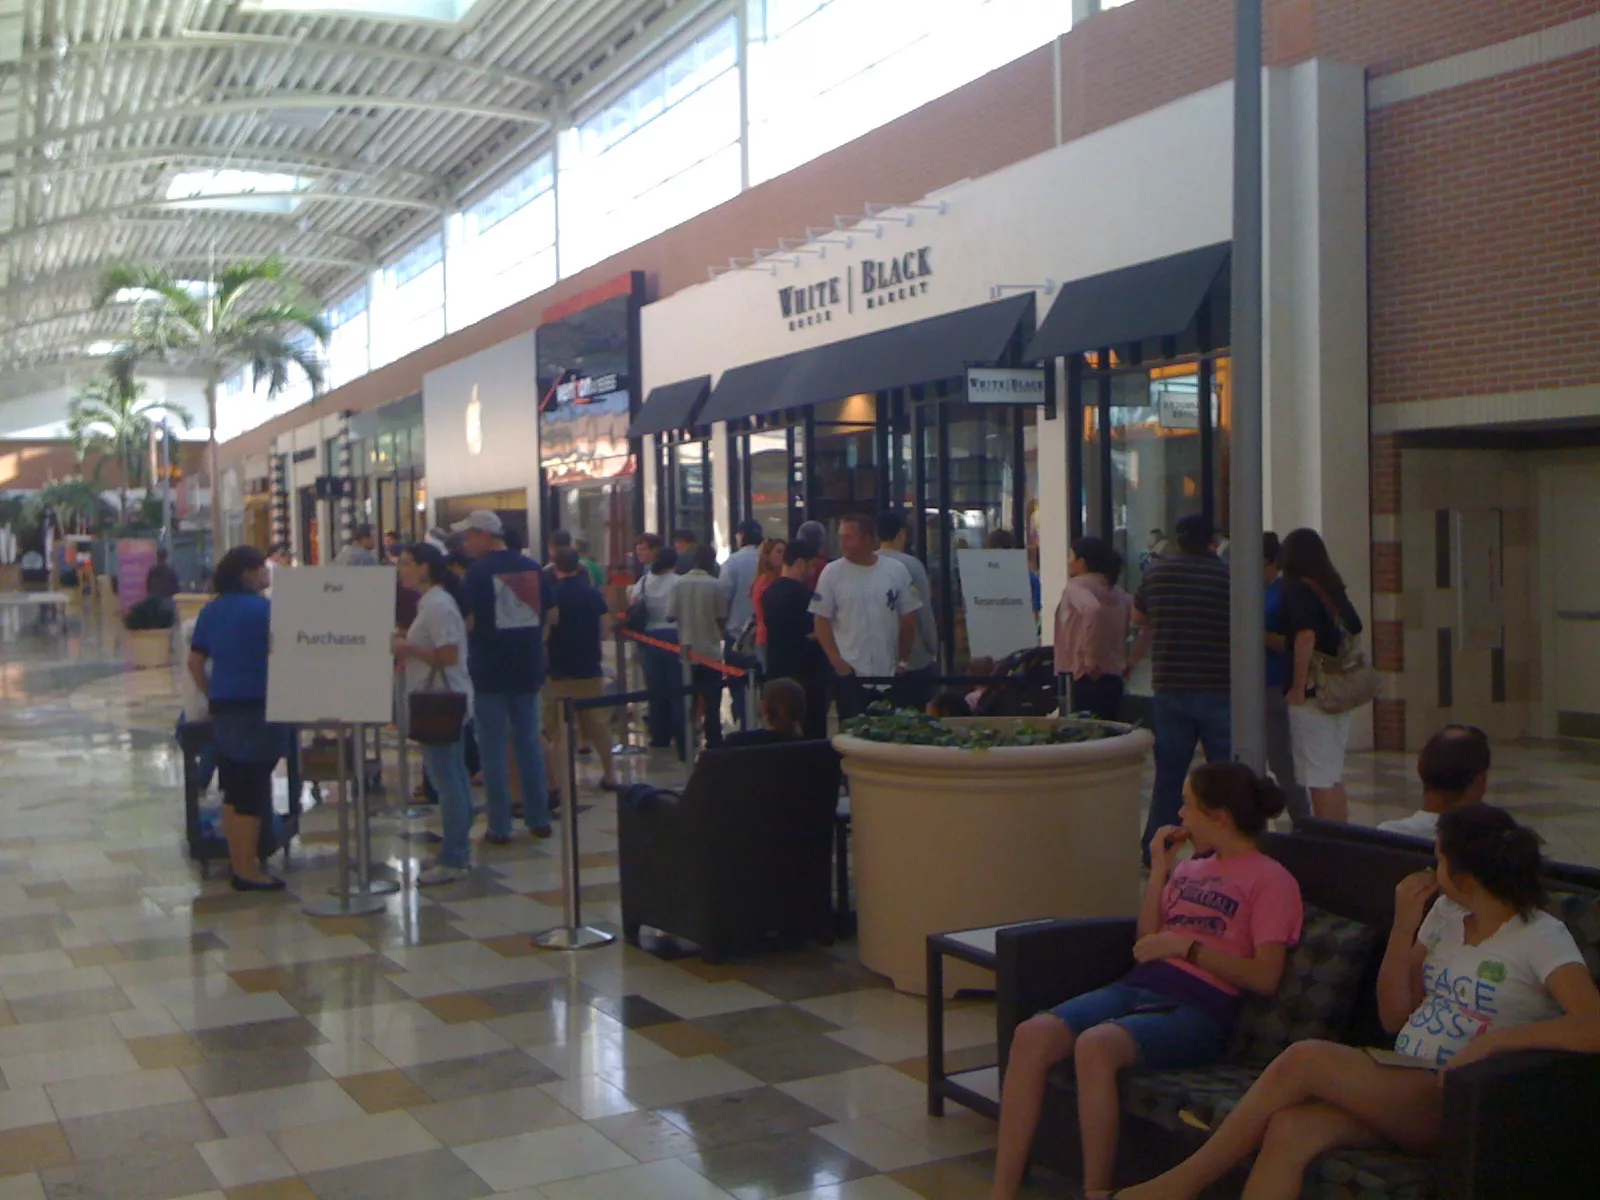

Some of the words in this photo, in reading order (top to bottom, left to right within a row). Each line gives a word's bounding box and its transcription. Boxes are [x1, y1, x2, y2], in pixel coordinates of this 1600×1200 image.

[778, 276, 840, 318] WHITE
[860, 246, 933, 294] BLACK
[867, 281, 928, 309] MARKET
[296, 629, 368, 646] Purchases
